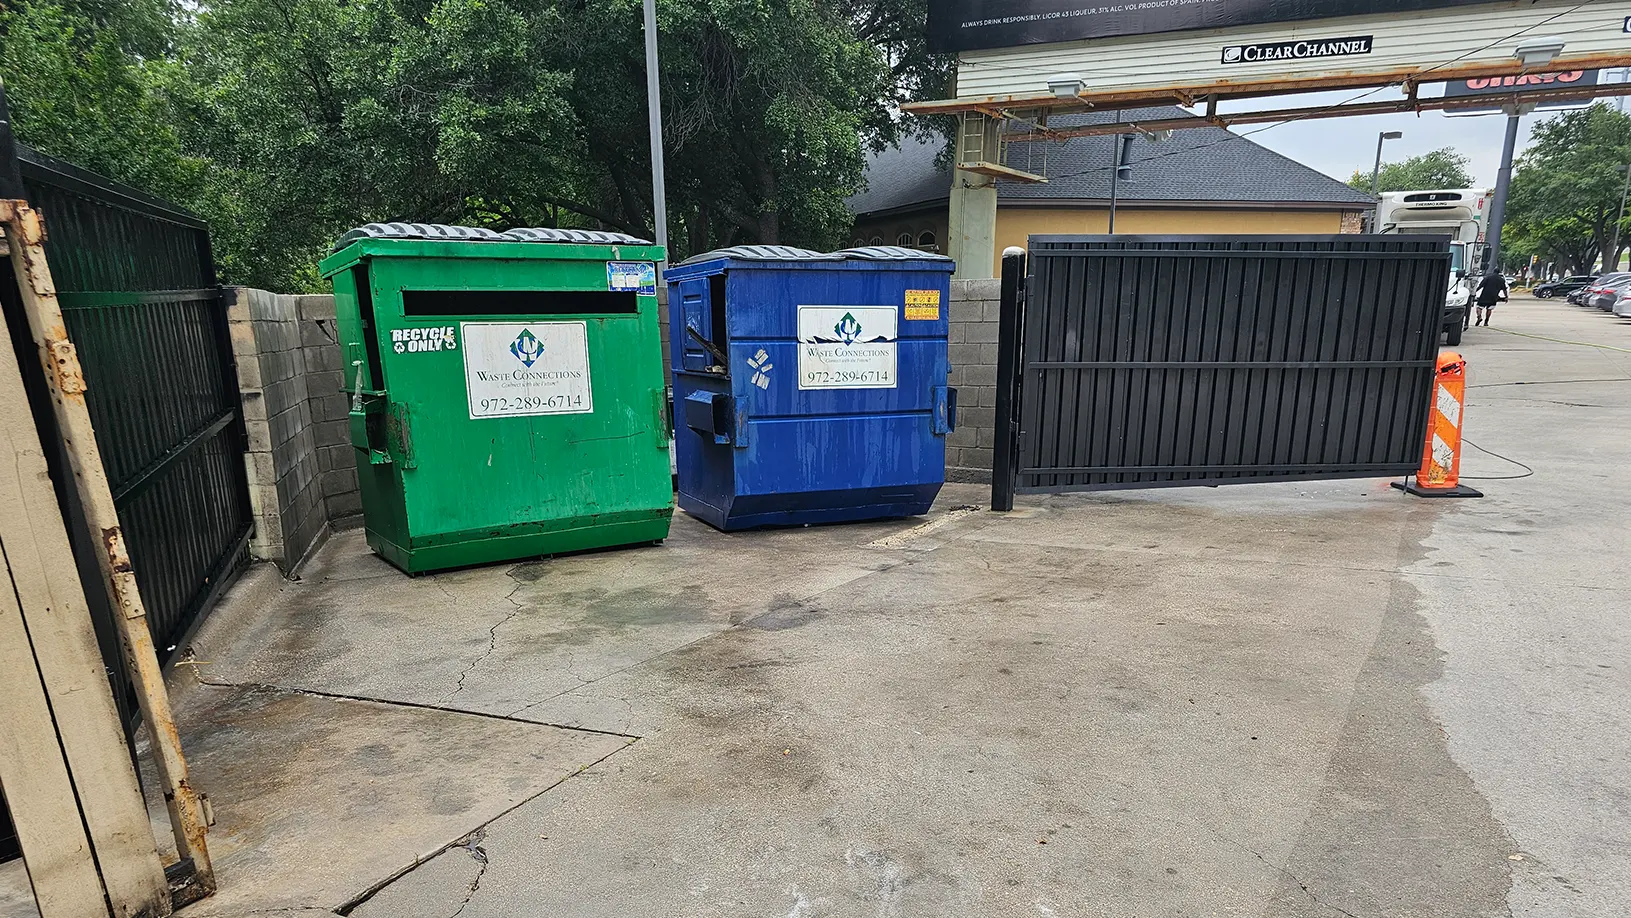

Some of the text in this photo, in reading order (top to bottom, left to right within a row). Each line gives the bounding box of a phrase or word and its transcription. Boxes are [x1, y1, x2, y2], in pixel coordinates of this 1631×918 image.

[961, 20, 983, 28] ALWAYS
[984, 18, 1002, 26] DRINK
[1002, 14, 1041, 24] RESPONSIBLY.
[1042, 11, 1060, 20] LICOR
[1061, 10, 1069, 18] 43
[1109, 5, 1123, 13] ALC.
[1138, 0, 1169, 9] PRODUCT
[391, 326, 455, 342] RECYCLE
[407, 339, 443, 352] ONLY
[807, 347, 890, 357] WASTE CONNECTIONS
[476, 369, 582, 381] WASTE CONNECTIONS
[808, 371, 888, 383] 972-289-6714
[480, 394, 582, 412] 972-289-6714
